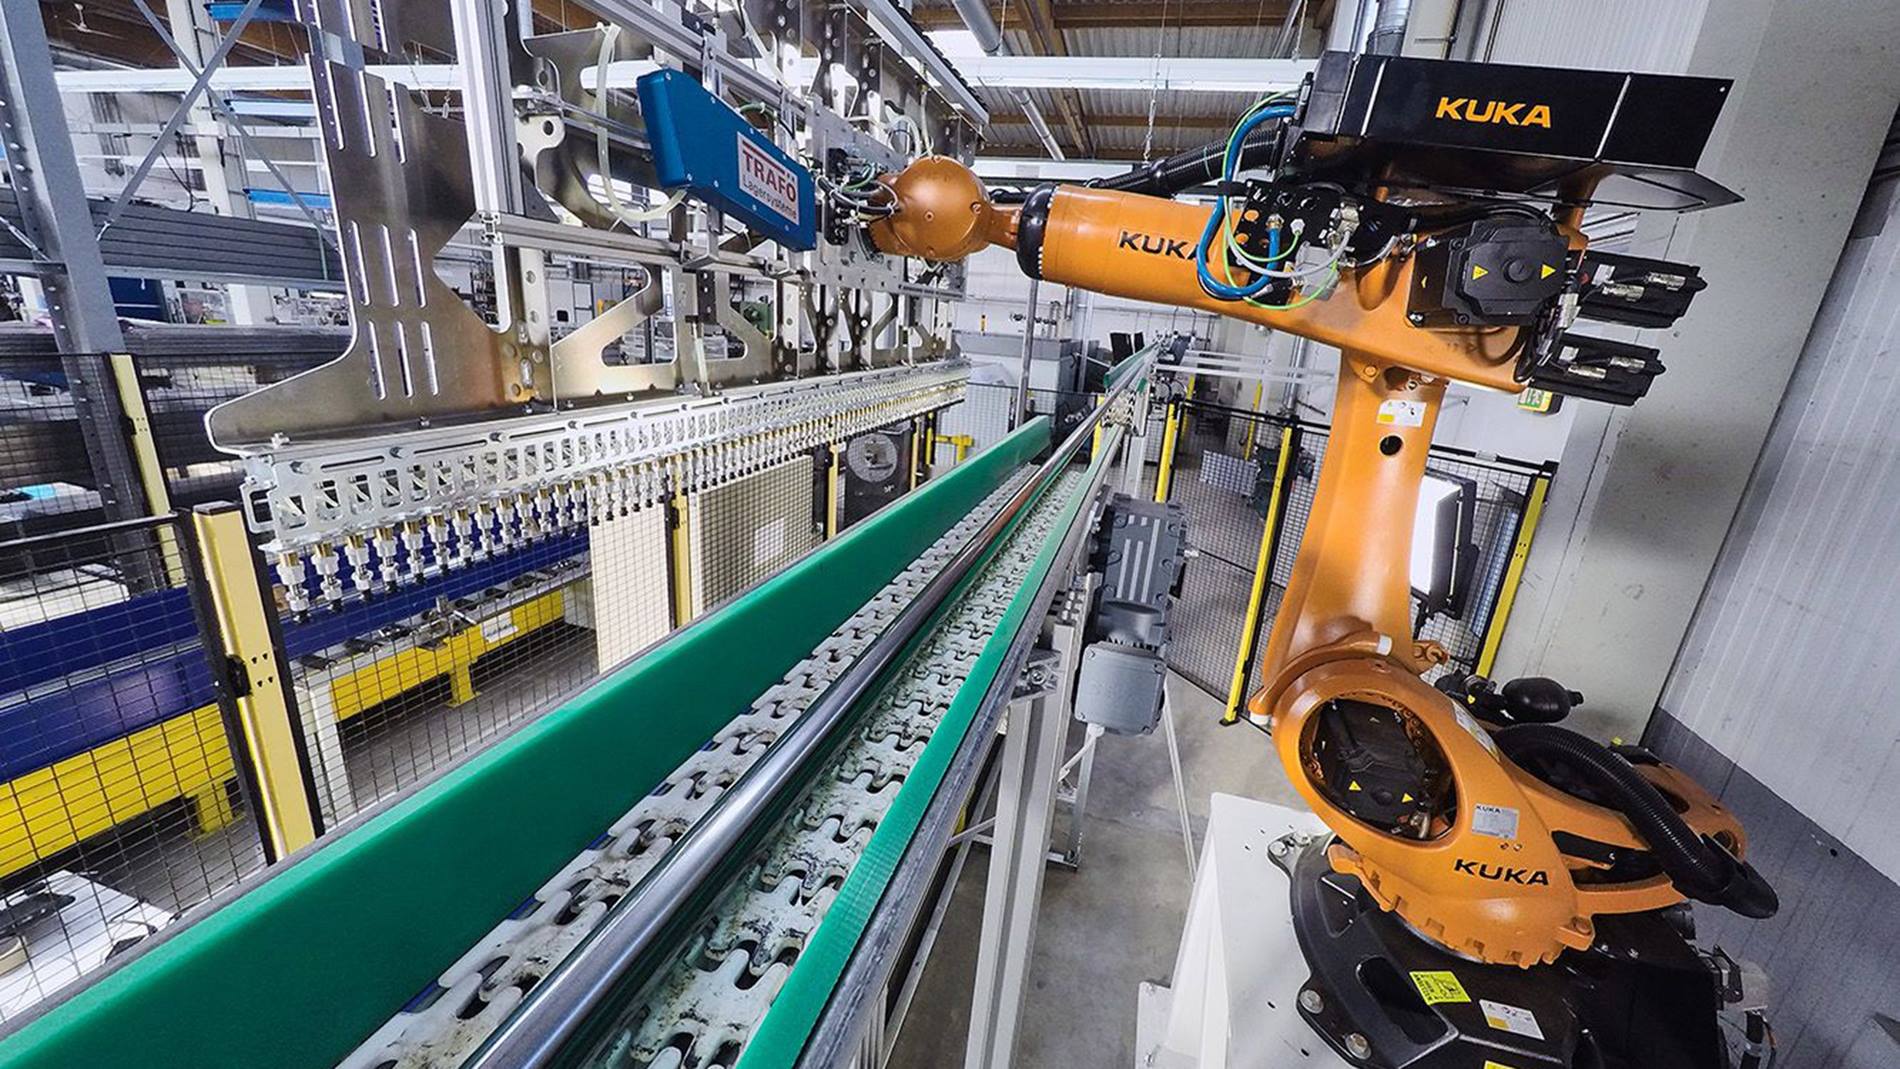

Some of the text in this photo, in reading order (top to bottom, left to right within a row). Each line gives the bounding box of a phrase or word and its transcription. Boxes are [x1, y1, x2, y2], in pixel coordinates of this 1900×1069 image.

[1435, 97, 1551, 128] KUKA
[1476, 804, 1501, 814] KUKA
[1454, 859, 1549, 886] KUKA
